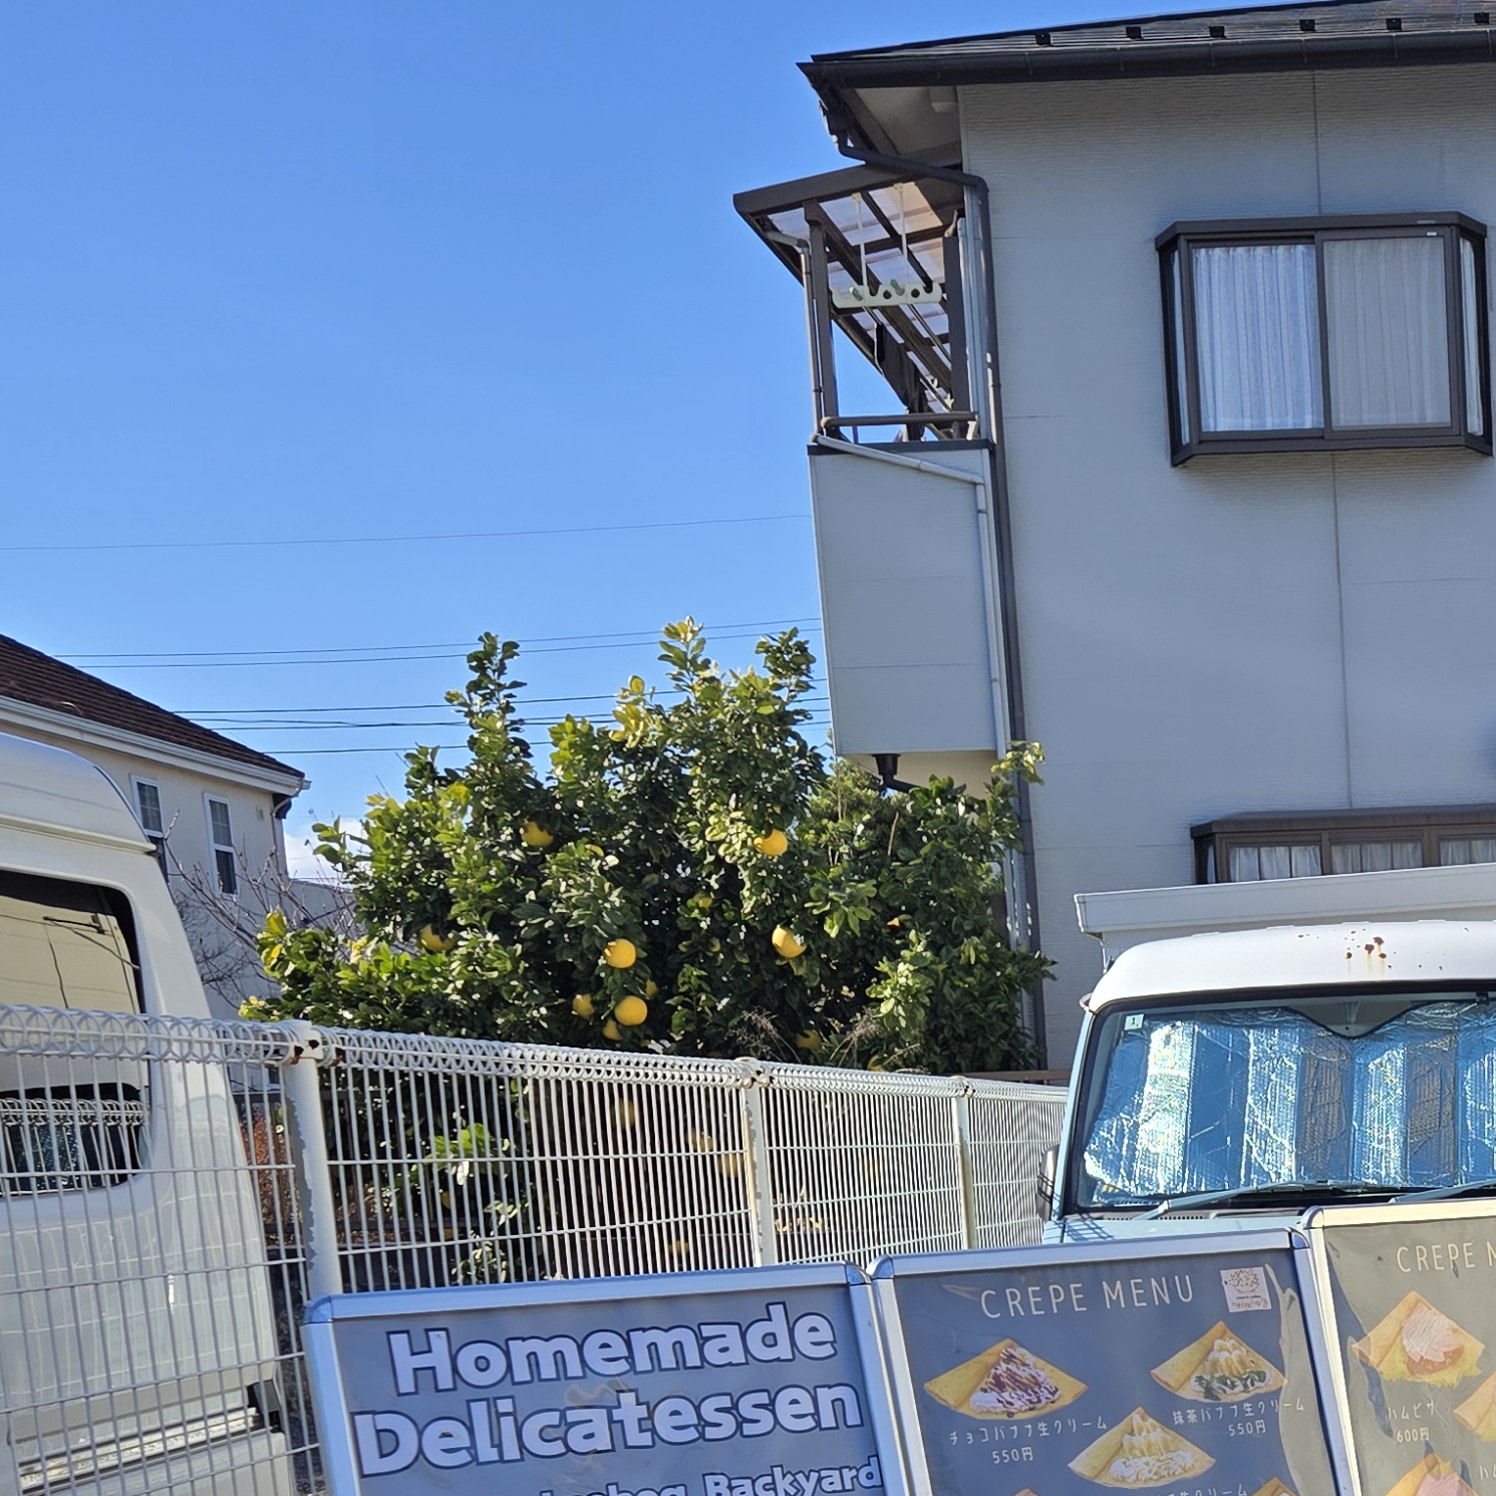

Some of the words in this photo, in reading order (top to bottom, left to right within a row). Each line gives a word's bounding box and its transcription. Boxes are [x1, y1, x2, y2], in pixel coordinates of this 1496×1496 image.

[1396, 1241, 1475, 1274] CREPE
[980, 1283, 1088, 1319] CREPE
[1102, 1274, 1195, 1309] MENU
[387, 1302, 837, 1396] Homemade
[1172, 1398, 1304, 1425] 抹茶バナナ生クリーム
[1388, 1400, 1436, 1421] ハムピザ
[352, 1383, 862, 1477] Delicatessen
[949, 1415, 1108, 1446] チョコバナナ生クリーム
[1228, 1420, 1266, 1437] 550円
[1397, 1427, 1430, 1443] 600円
[992, 1446, 1034, 1464] 550円
